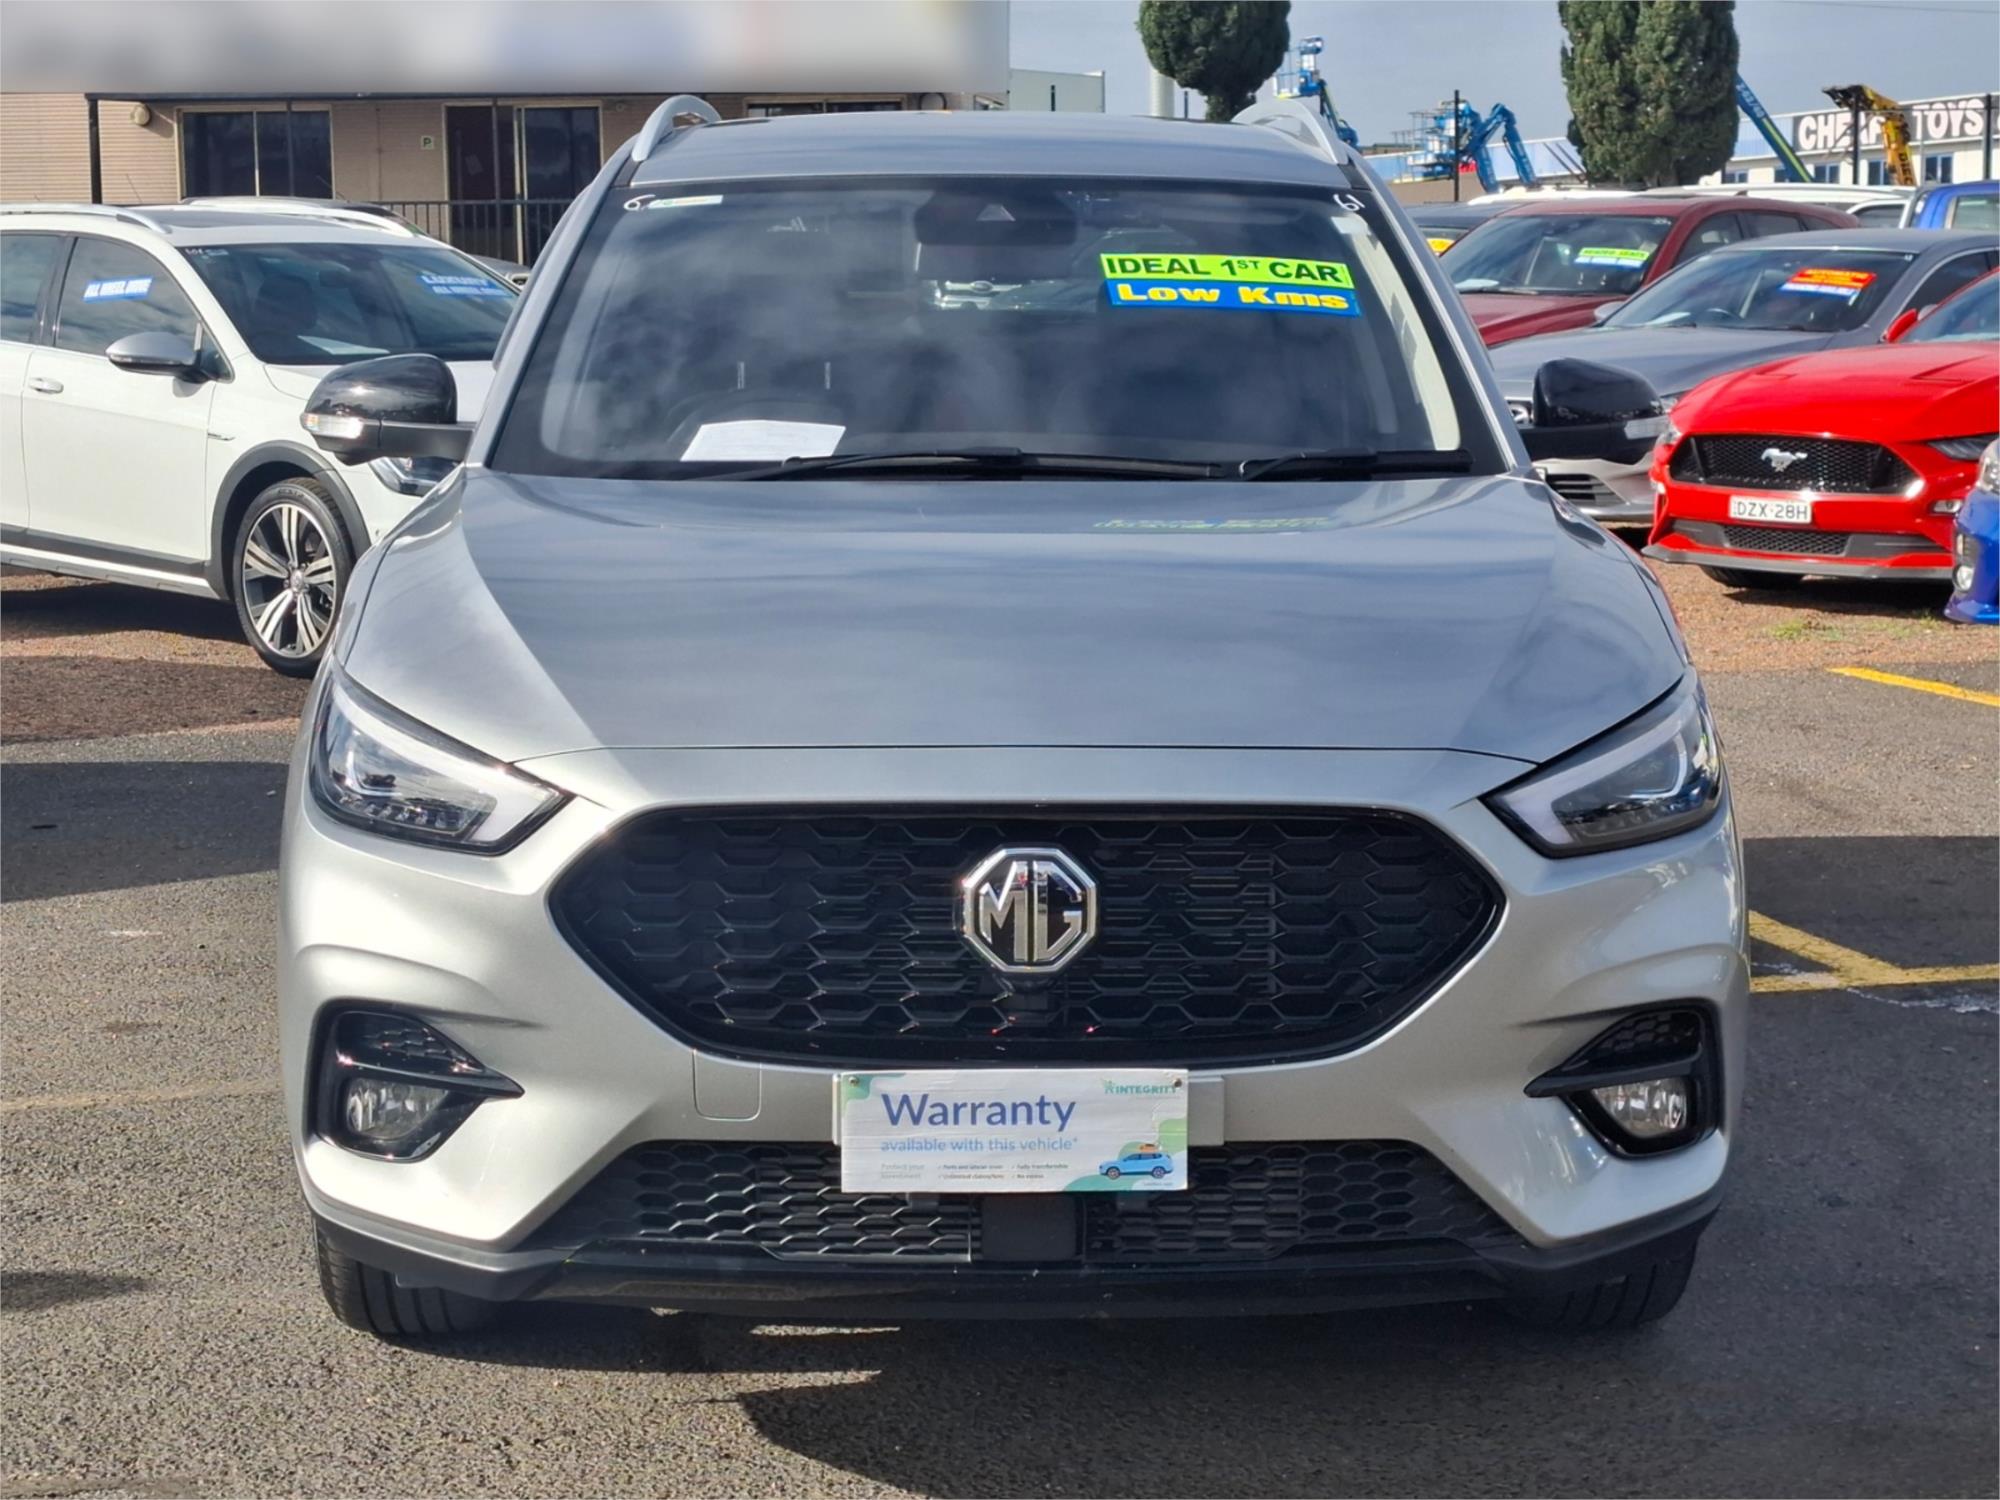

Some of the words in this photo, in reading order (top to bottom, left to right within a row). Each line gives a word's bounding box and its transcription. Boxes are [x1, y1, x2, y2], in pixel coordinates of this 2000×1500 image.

[1912, 98, 1985, 140] TOYS
[1105, 257, 1212, 276] IDEAL
[1220, 260, 1261, 276] 1ST
[1268, 262, 1343, 283] CAR
[1237, 286, 1350, 309] Kms
[979, 861, 1082, 962] MG
[881, 1093, 1077, 1132] Warranty
[881, 1137, 947, 1152] available
[950, 1138, 984, 1151] with
[988, 1137, 1015, 1151] this
